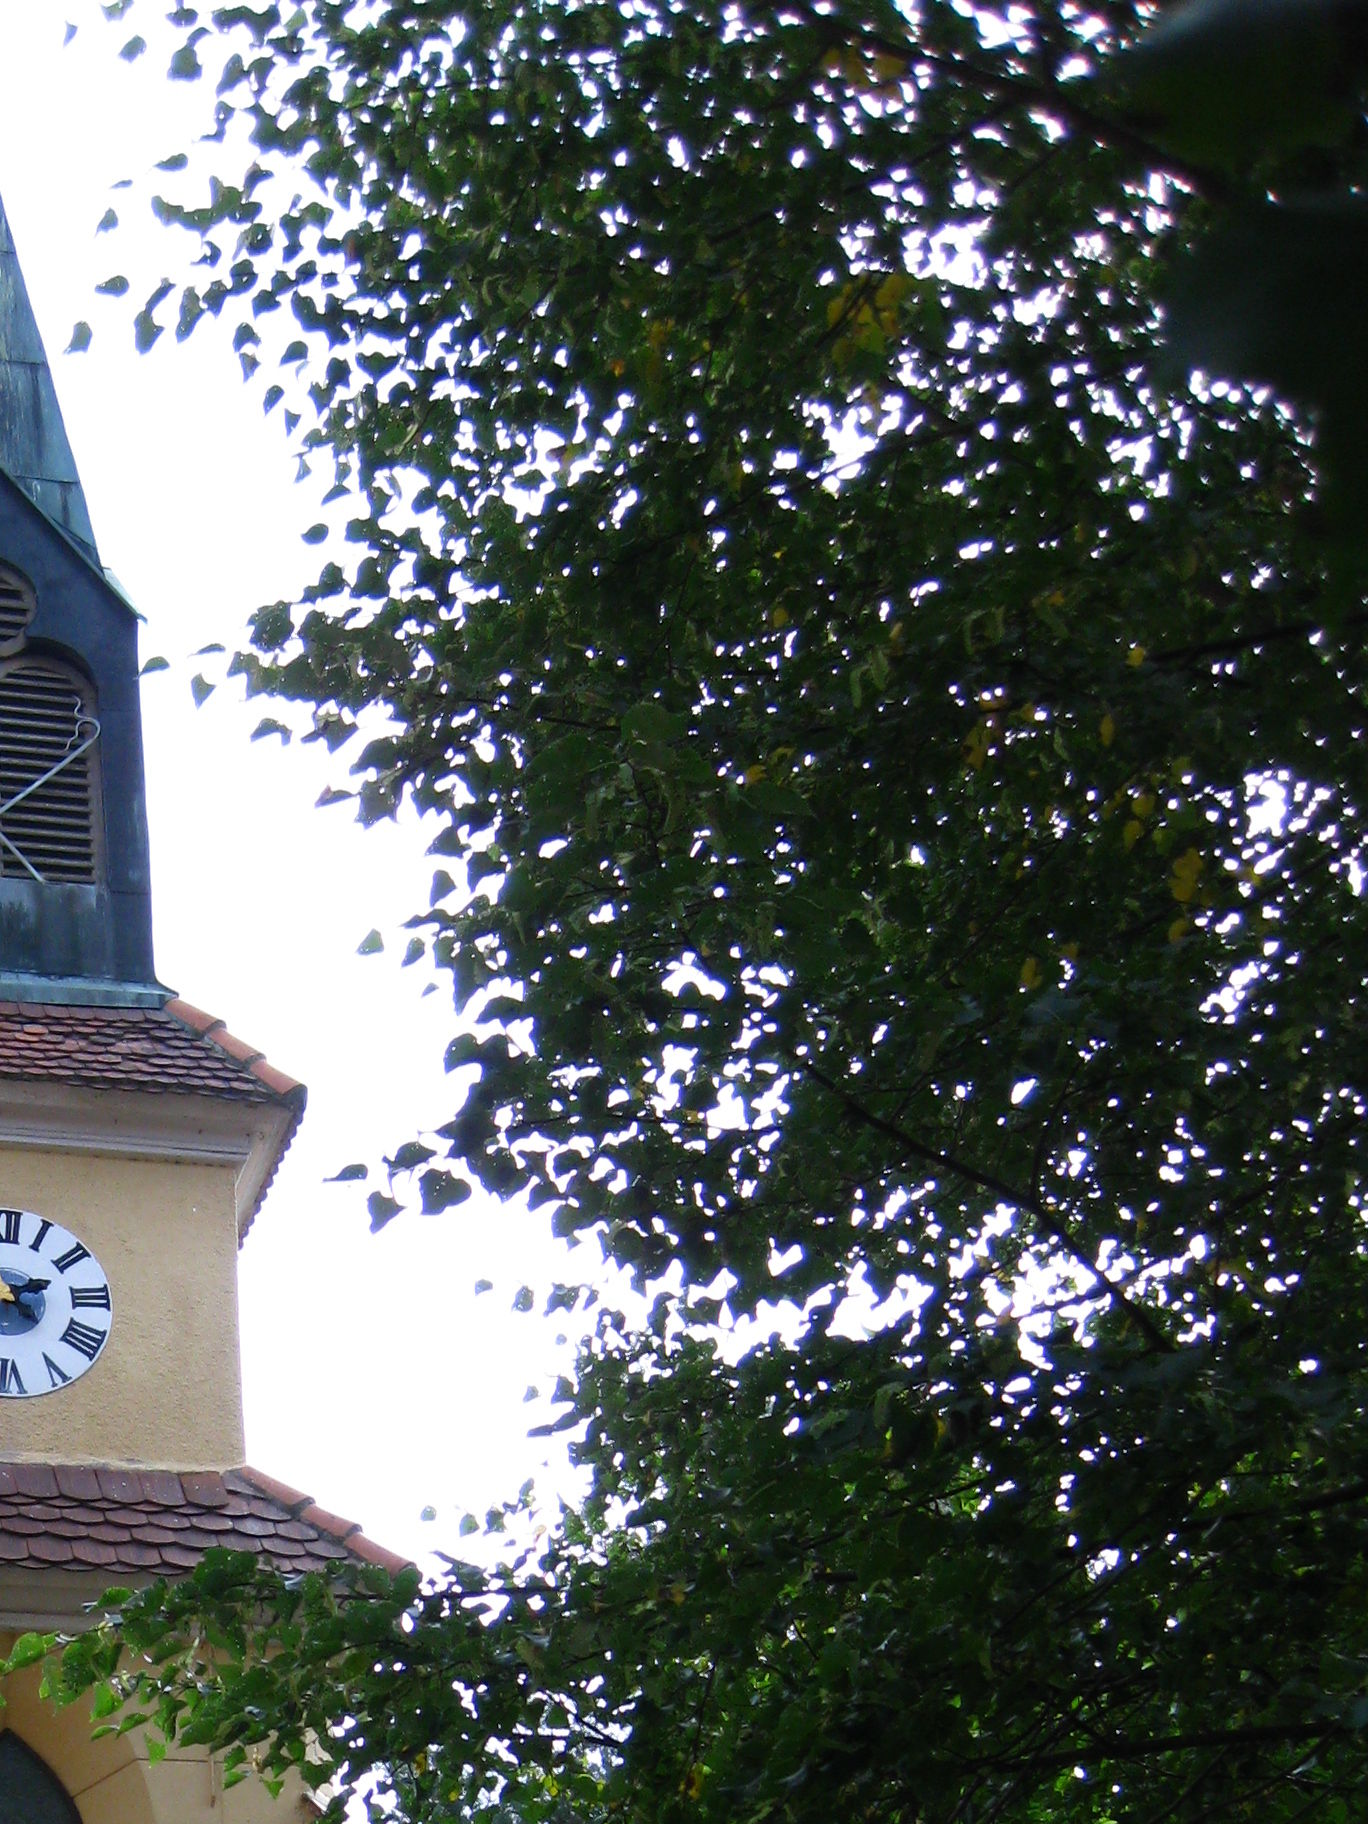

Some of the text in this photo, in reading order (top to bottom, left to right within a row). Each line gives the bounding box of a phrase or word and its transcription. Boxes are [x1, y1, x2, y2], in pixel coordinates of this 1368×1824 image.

[29, 1218, 54, 1252] I
[50, 1241, 92, 1274] II
[69, 1284, 111, 1311] III
[42, 1352, 72, 1387] V
